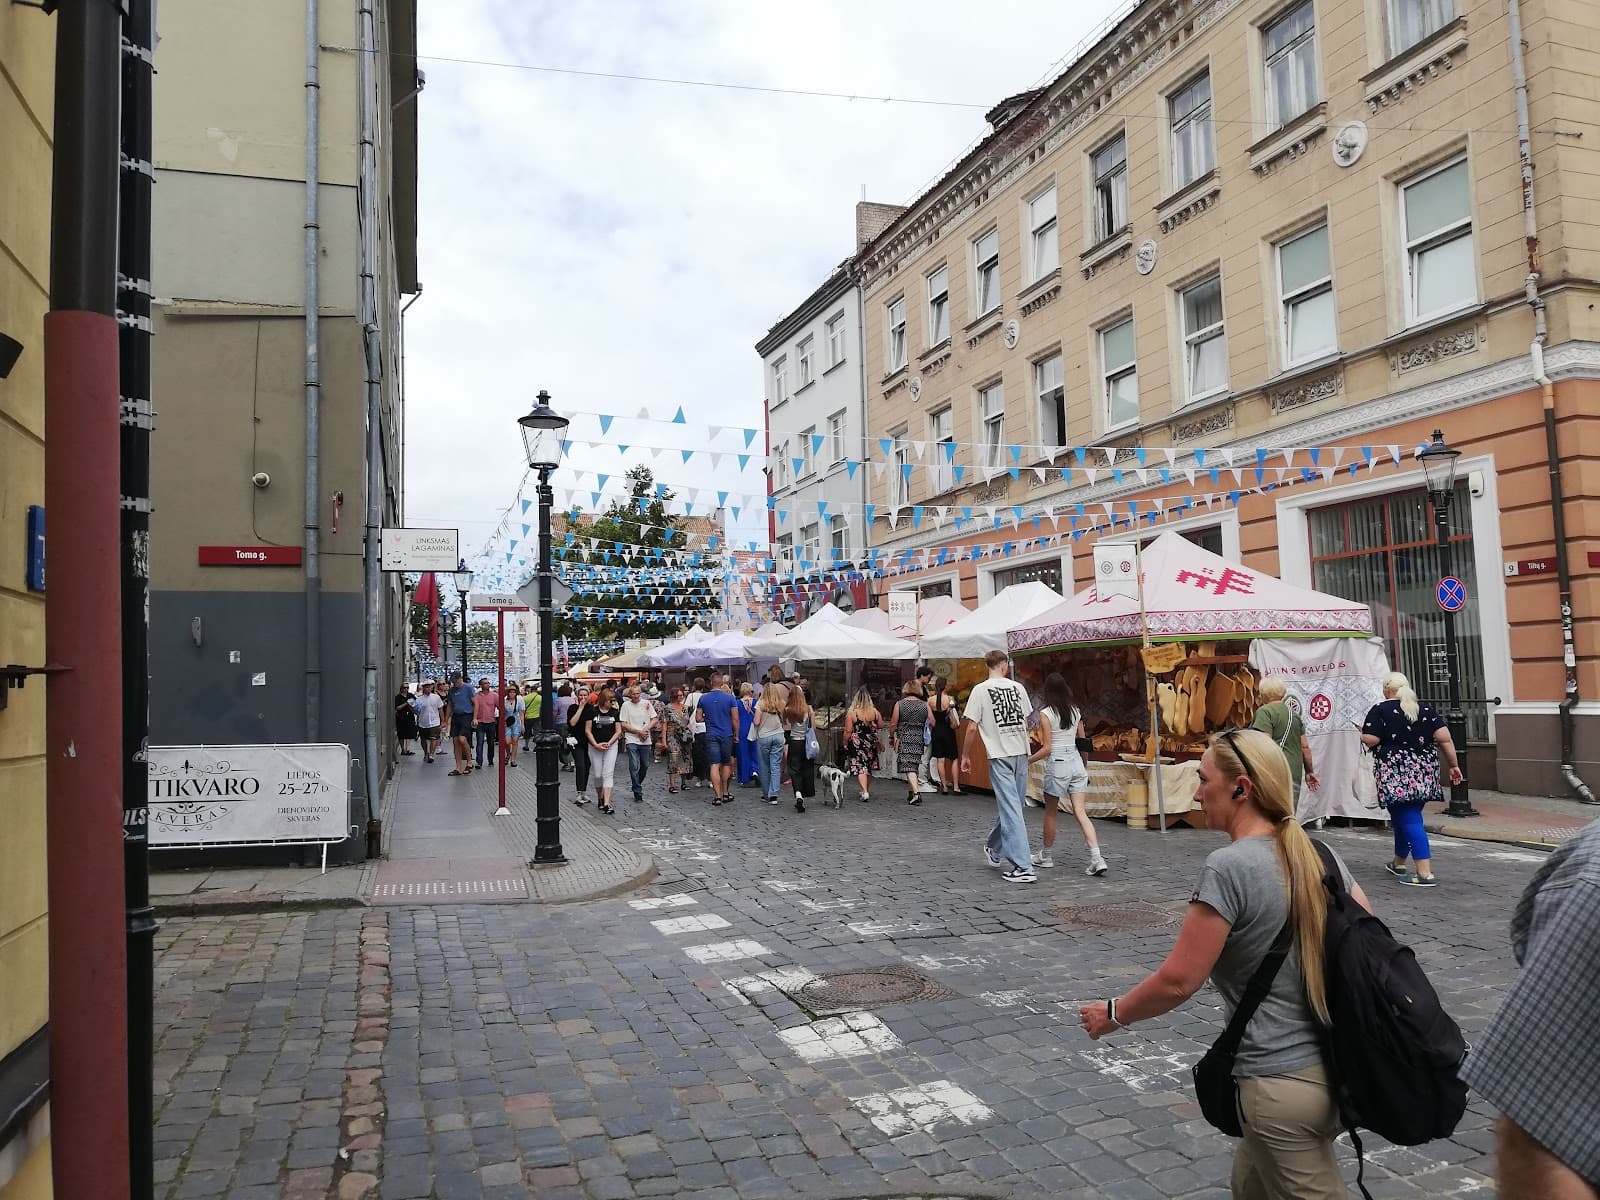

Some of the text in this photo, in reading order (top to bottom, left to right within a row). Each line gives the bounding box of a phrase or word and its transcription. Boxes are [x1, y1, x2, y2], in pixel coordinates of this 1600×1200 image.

[235, 550, 267, 560] Tomo g.
[1508, 564, 1514, 573] 9
[488, 596, 507, 604] Tomo
[993, 708, 1024, 724] EVER
[287, 771, 321, 780] LIEPOS
[148, 805, 229, 825] KVERAS
[287, 814, 321, 823] SKVERAS
